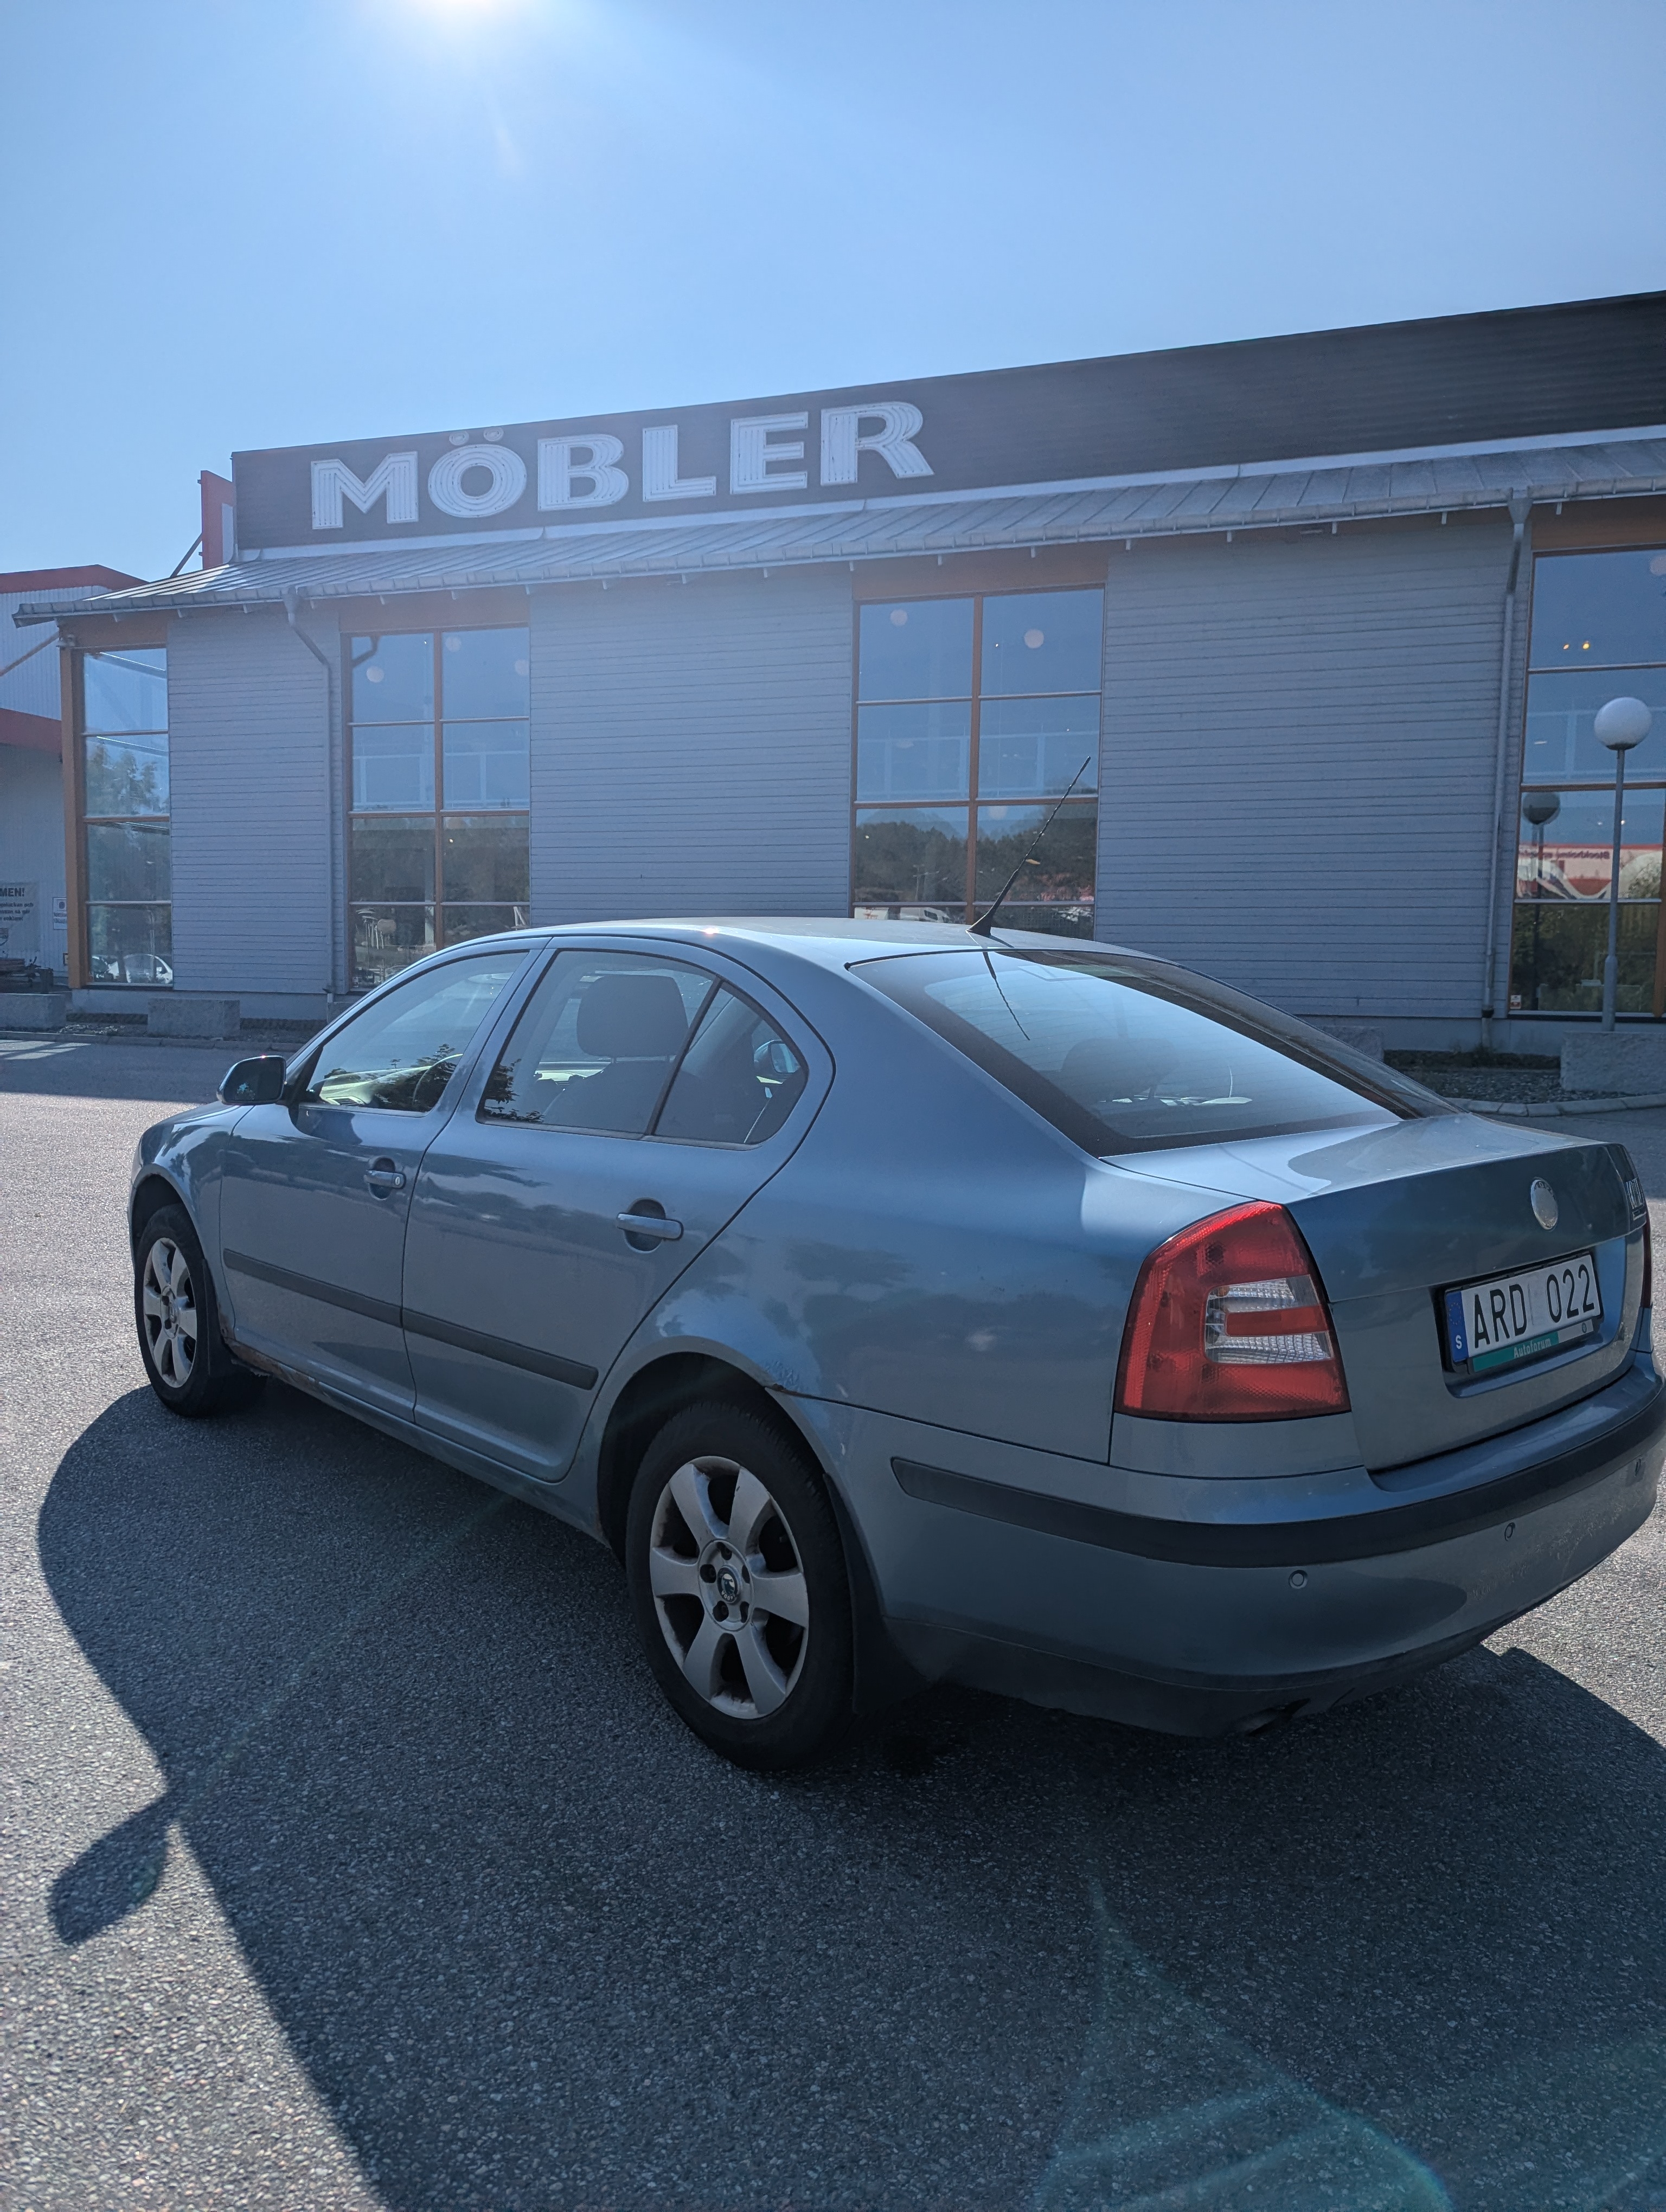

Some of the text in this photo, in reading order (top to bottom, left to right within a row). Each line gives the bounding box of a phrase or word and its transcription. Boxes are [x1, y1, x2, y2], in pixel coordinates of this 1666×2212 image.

[310, 399, 935, 530] MÖBLER
[1473, 1264, 1595, 1349] ARD 022
[1455, 1334, 1463, 1349] S
[1513, 1338, 1552, 1359] Autoforum
